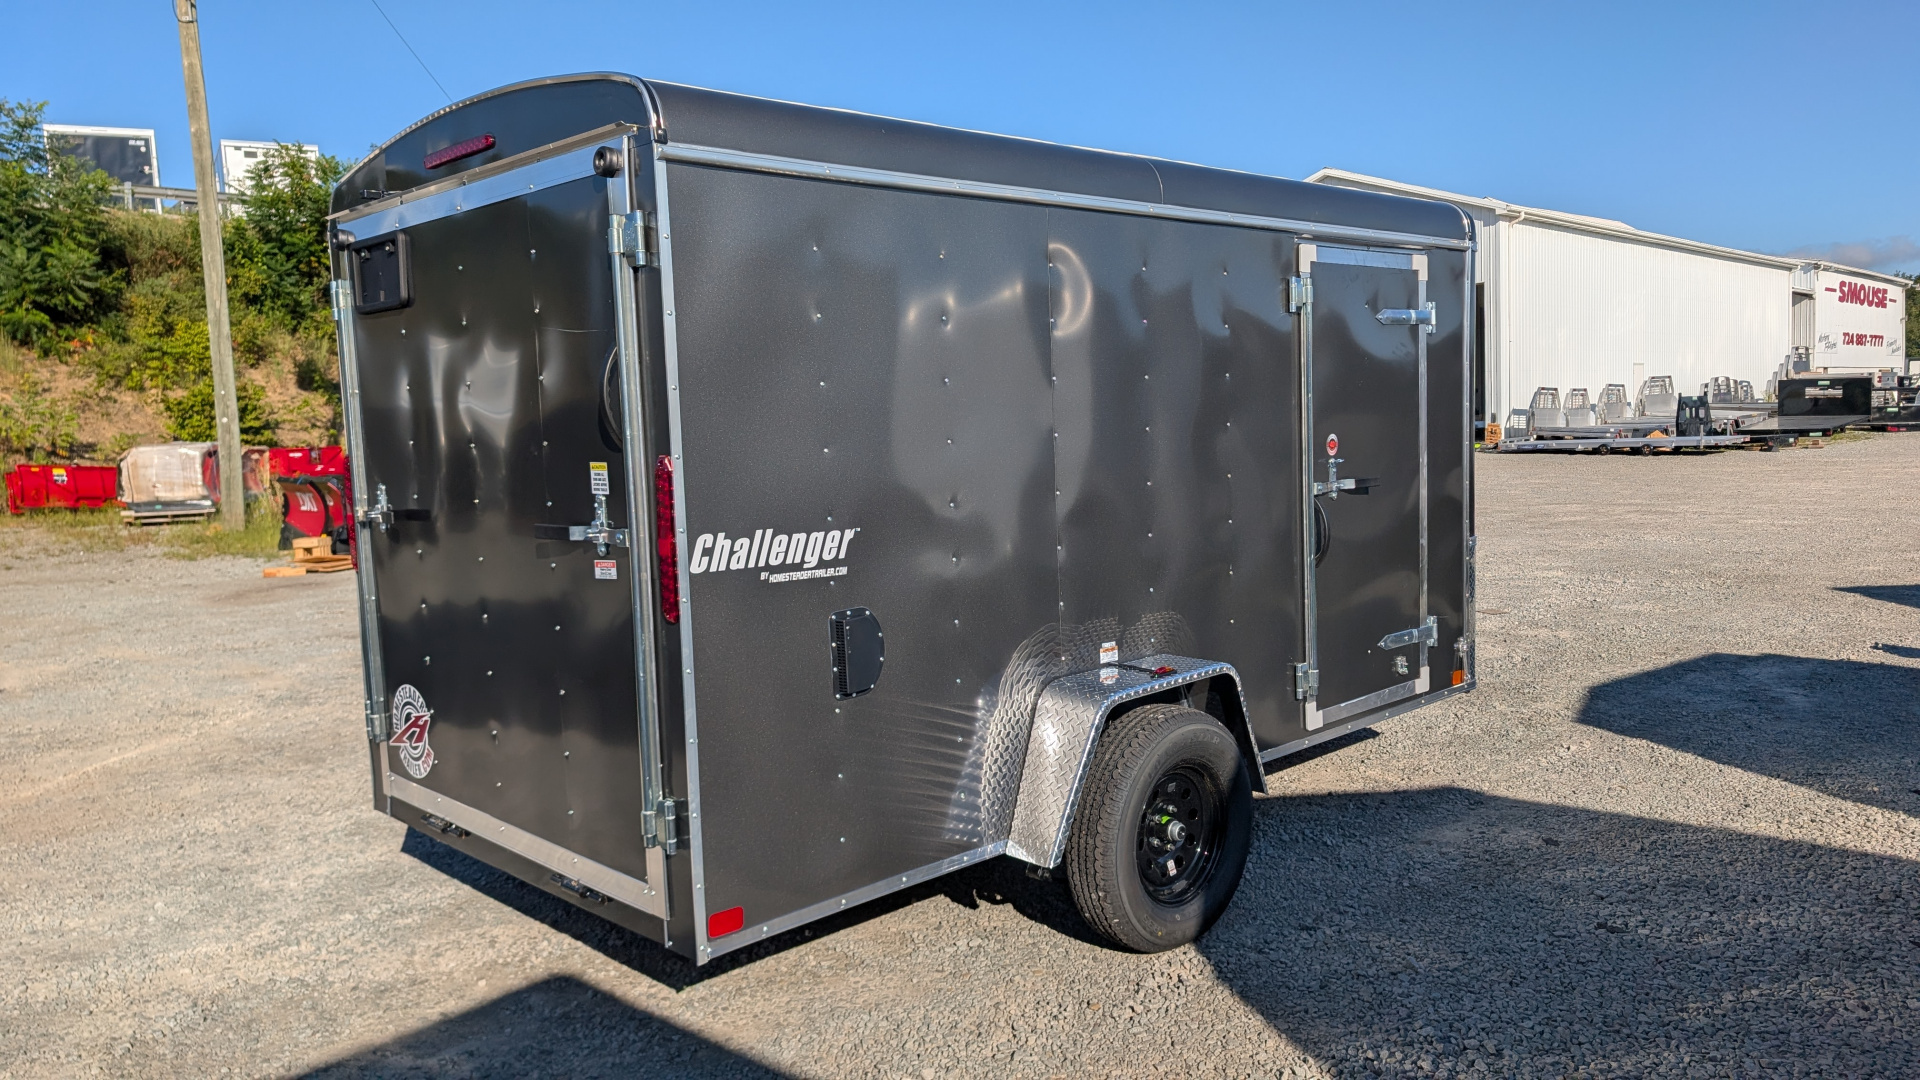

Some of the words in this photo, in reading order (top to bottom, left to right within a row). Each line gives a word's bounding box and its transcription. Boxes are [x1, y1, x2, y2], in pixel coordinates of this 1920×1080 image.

[1838, 280, 1888, 309] SMOUSE
[1843, 332, 1855, 346] 724
[1855, 333, 1884, 347] 887-7777
[690, 528, 855, 574] Challenger
[760, 571, 769, 580] BY
